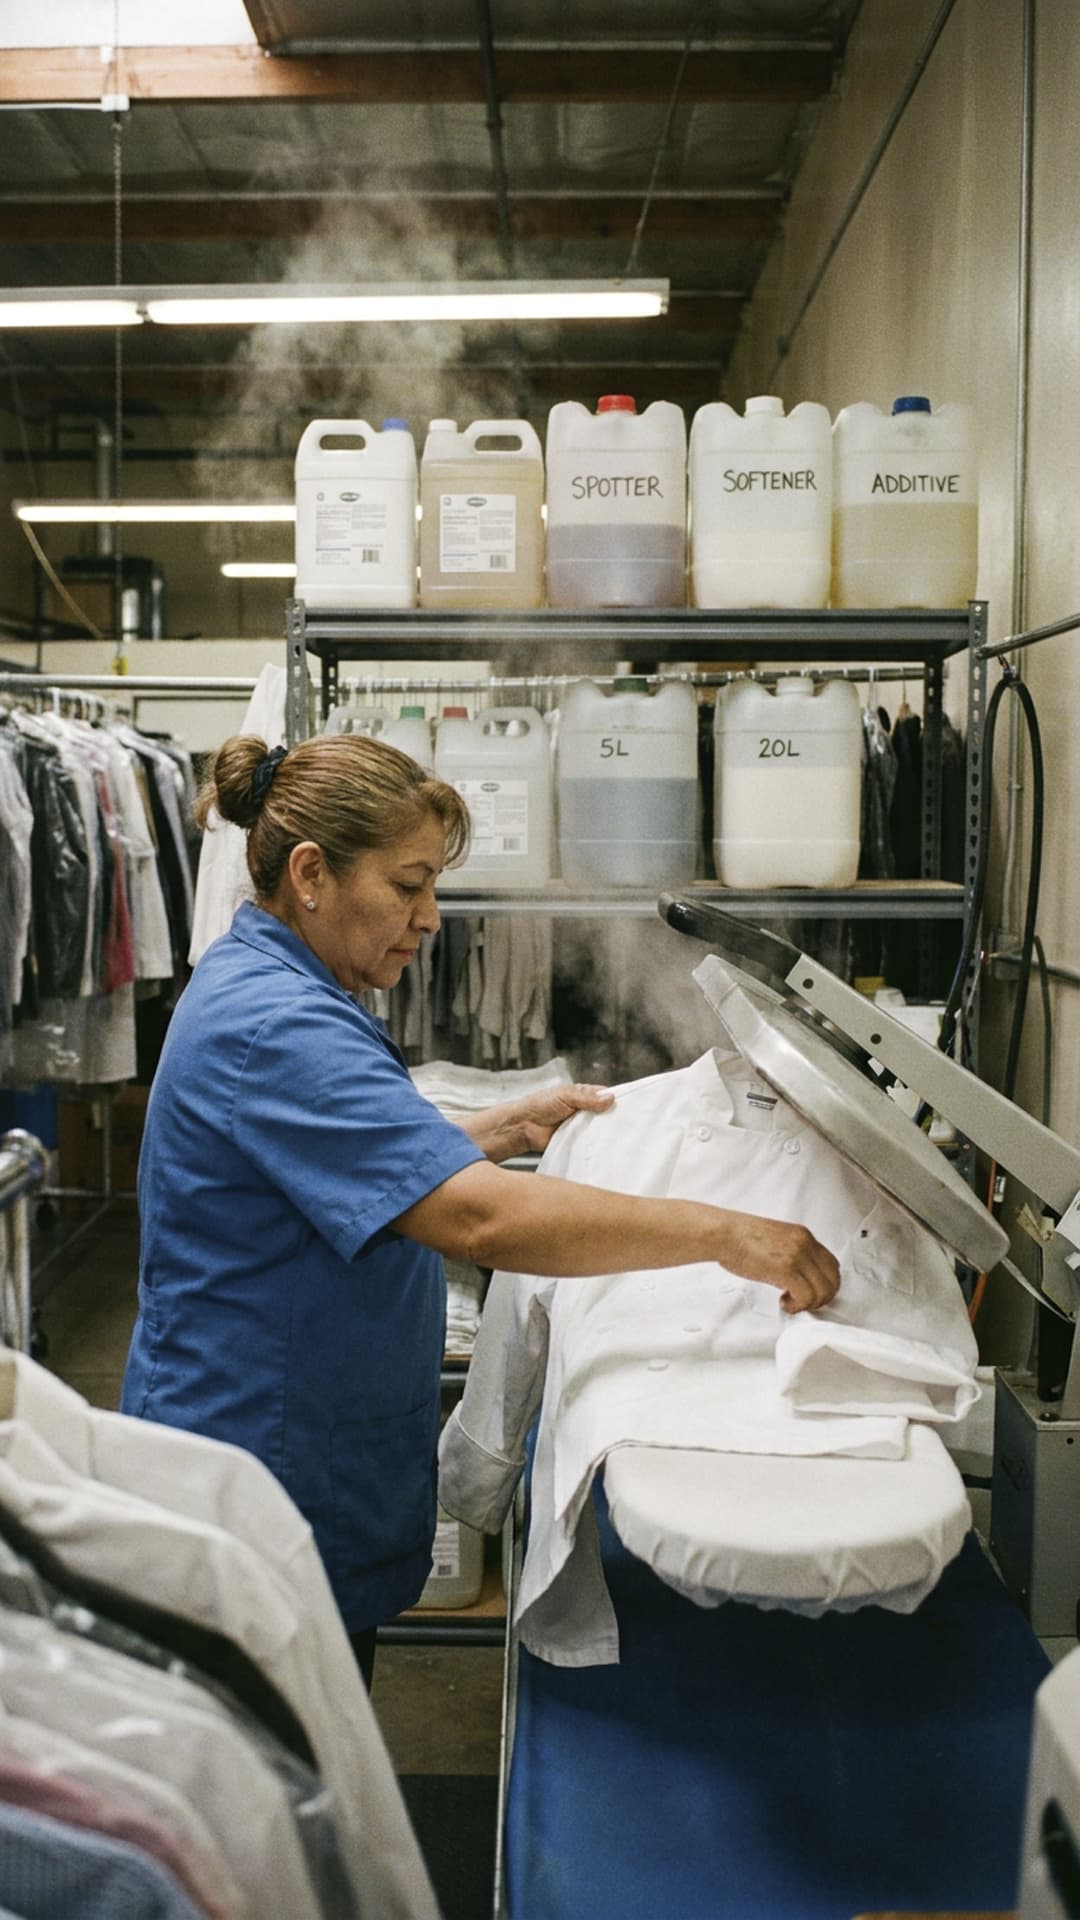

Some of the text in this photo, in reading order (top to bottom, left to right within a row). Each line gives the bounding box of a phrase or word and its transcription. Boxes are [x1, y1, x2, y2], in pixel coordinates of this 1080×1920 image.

[571, 475, 664, 500] SPOTTER
[722, 468, 818, 493] SOFTENER
[871, 472, 961, 494] ADDITIVE
[599, 738, 630, 759] 5L
[758, 737, 801, 759] 20L
